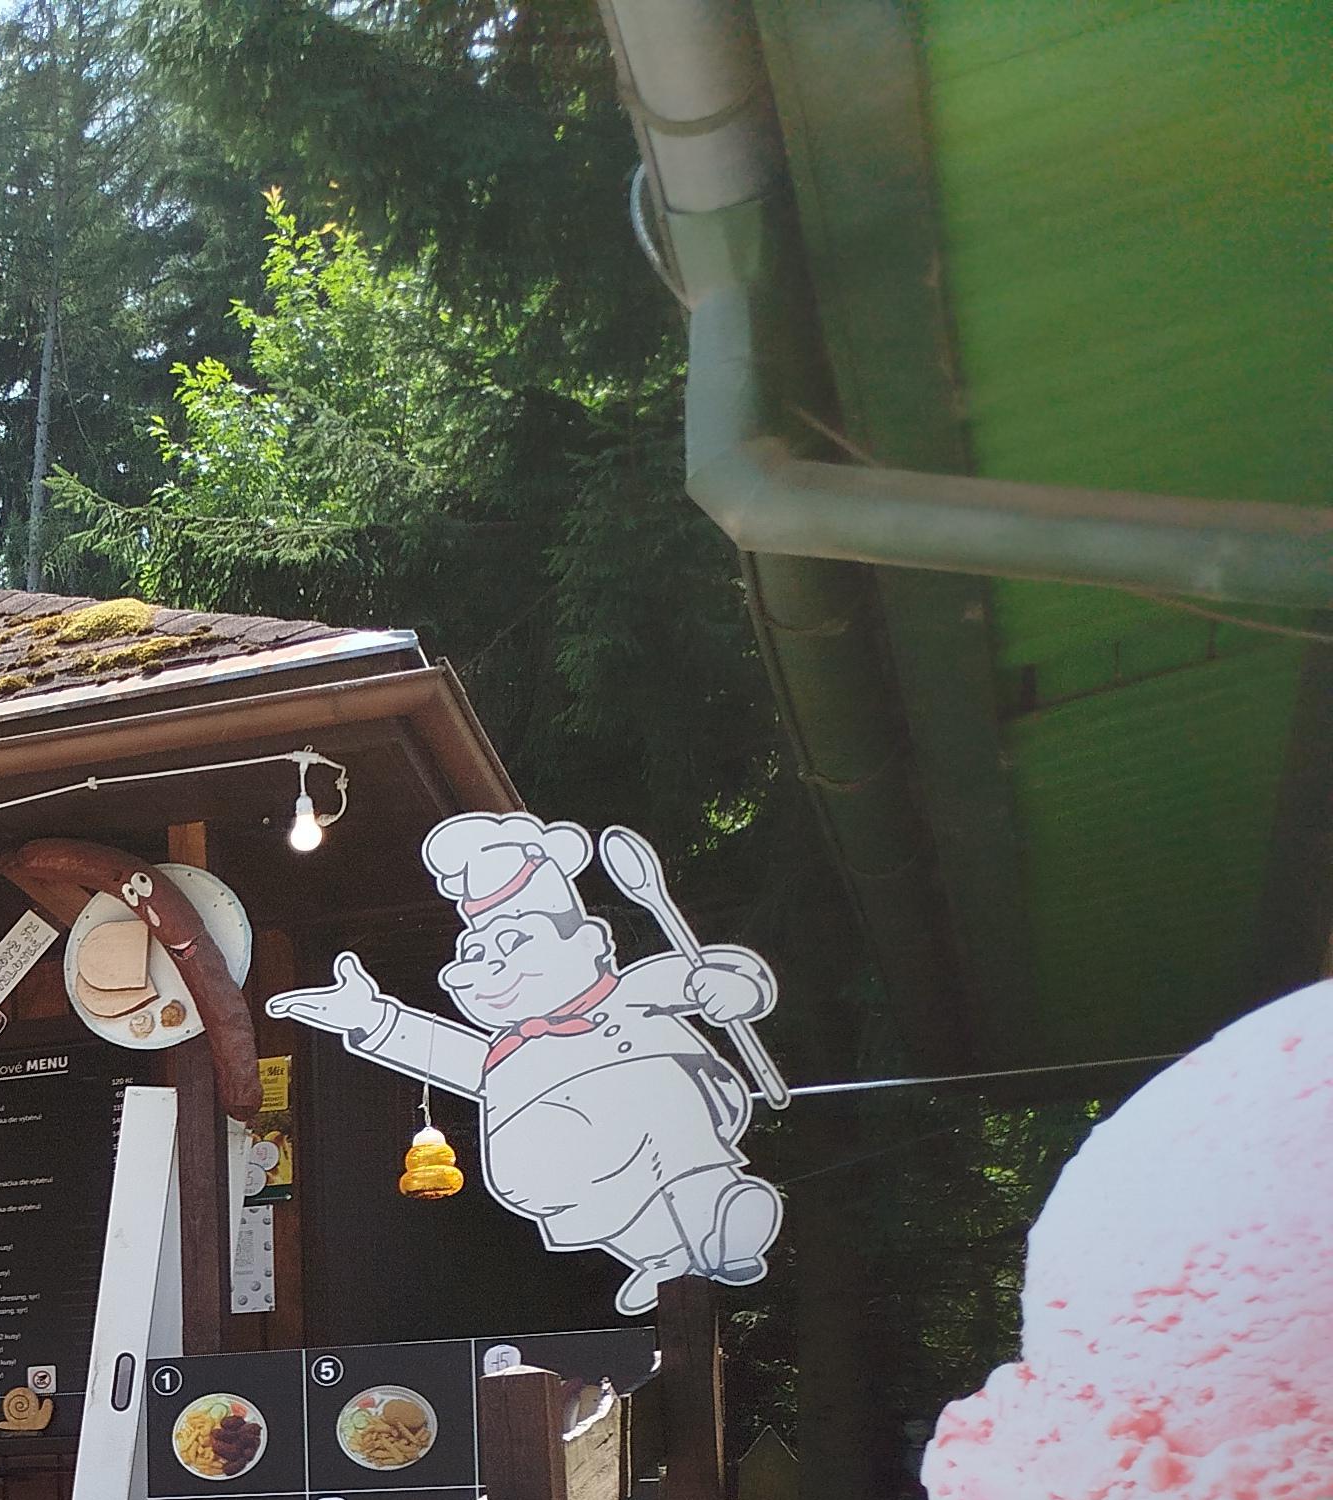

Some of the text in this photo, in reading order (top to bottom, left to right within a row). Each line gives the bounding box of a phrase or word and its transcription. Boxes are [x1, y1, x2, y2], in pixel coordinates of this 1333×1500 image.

[26, 1055, 69, 1072] MENU
[320, 1362, 335, 1380] 5
[162, 1373, 171, 1390] 1
